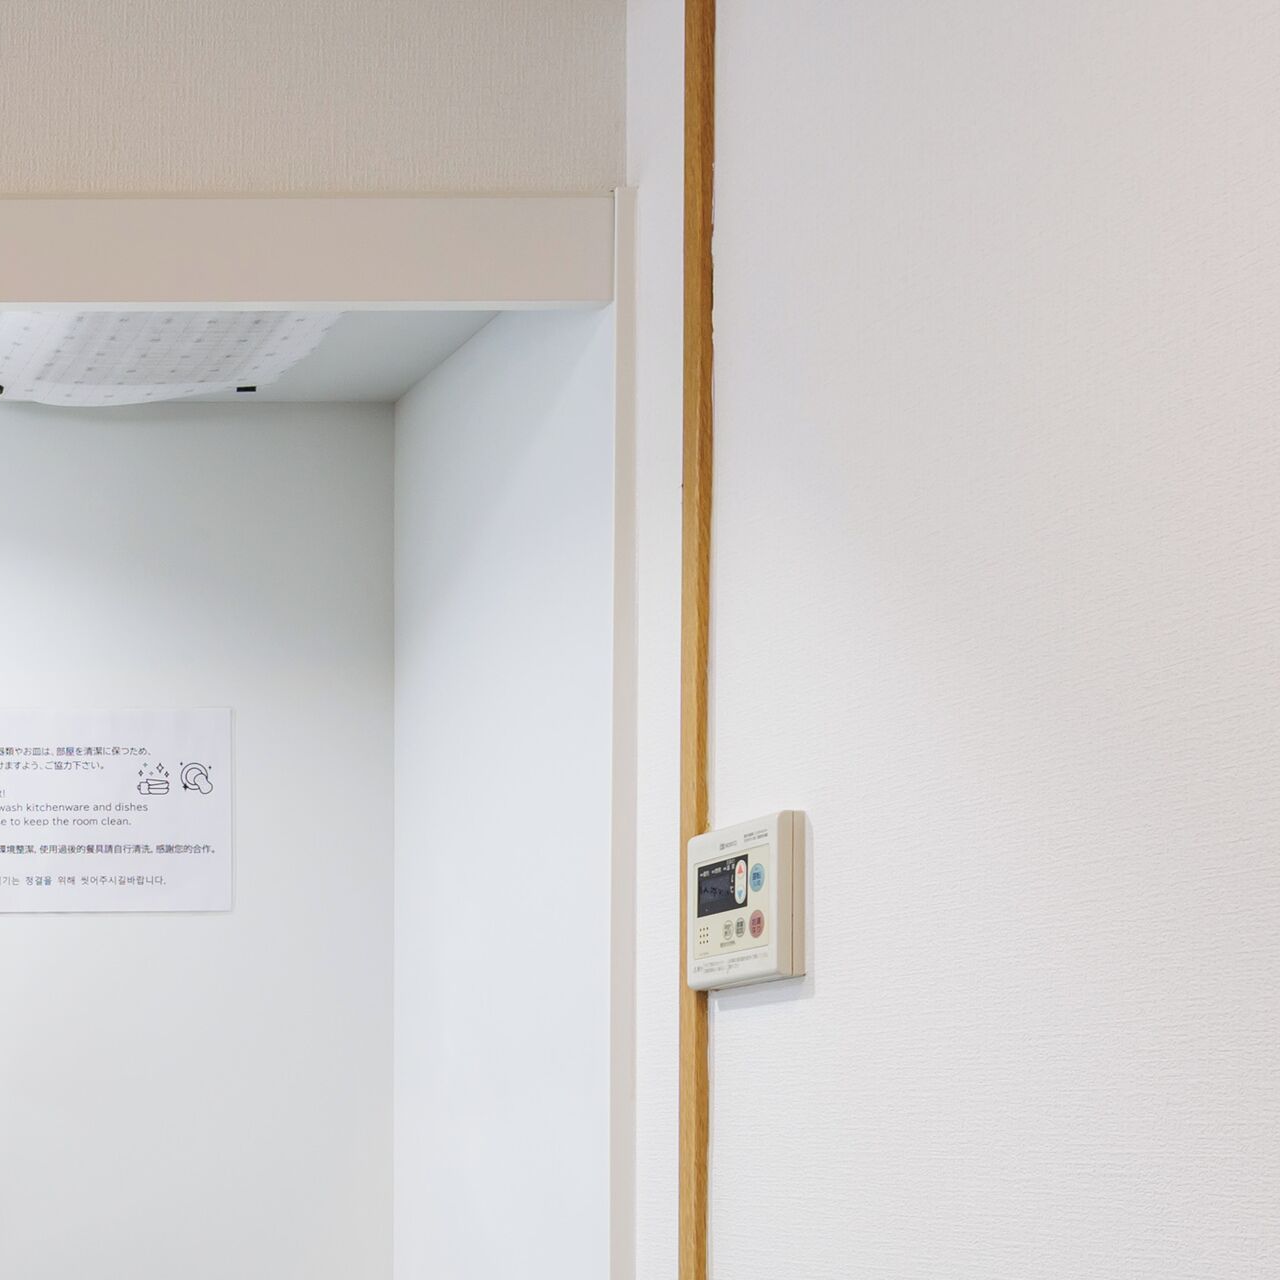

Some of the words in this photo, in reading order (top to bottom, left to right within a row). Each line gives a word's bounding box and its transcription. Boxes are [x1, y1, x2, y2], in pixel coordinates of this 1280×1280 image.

[26, 803, 90, 813] kitchenware
[93, 803, 112, 813] and
[114, 803, 149, 813] dishes
[10, 818, 21, 827] to
[23, 817, 49, 829] keep
[52, 817, 70, 827] the
[72, 818, 98, 827] room
[101, 817, 132, 827] clean.
[57, 875, 76, 886] 위해
